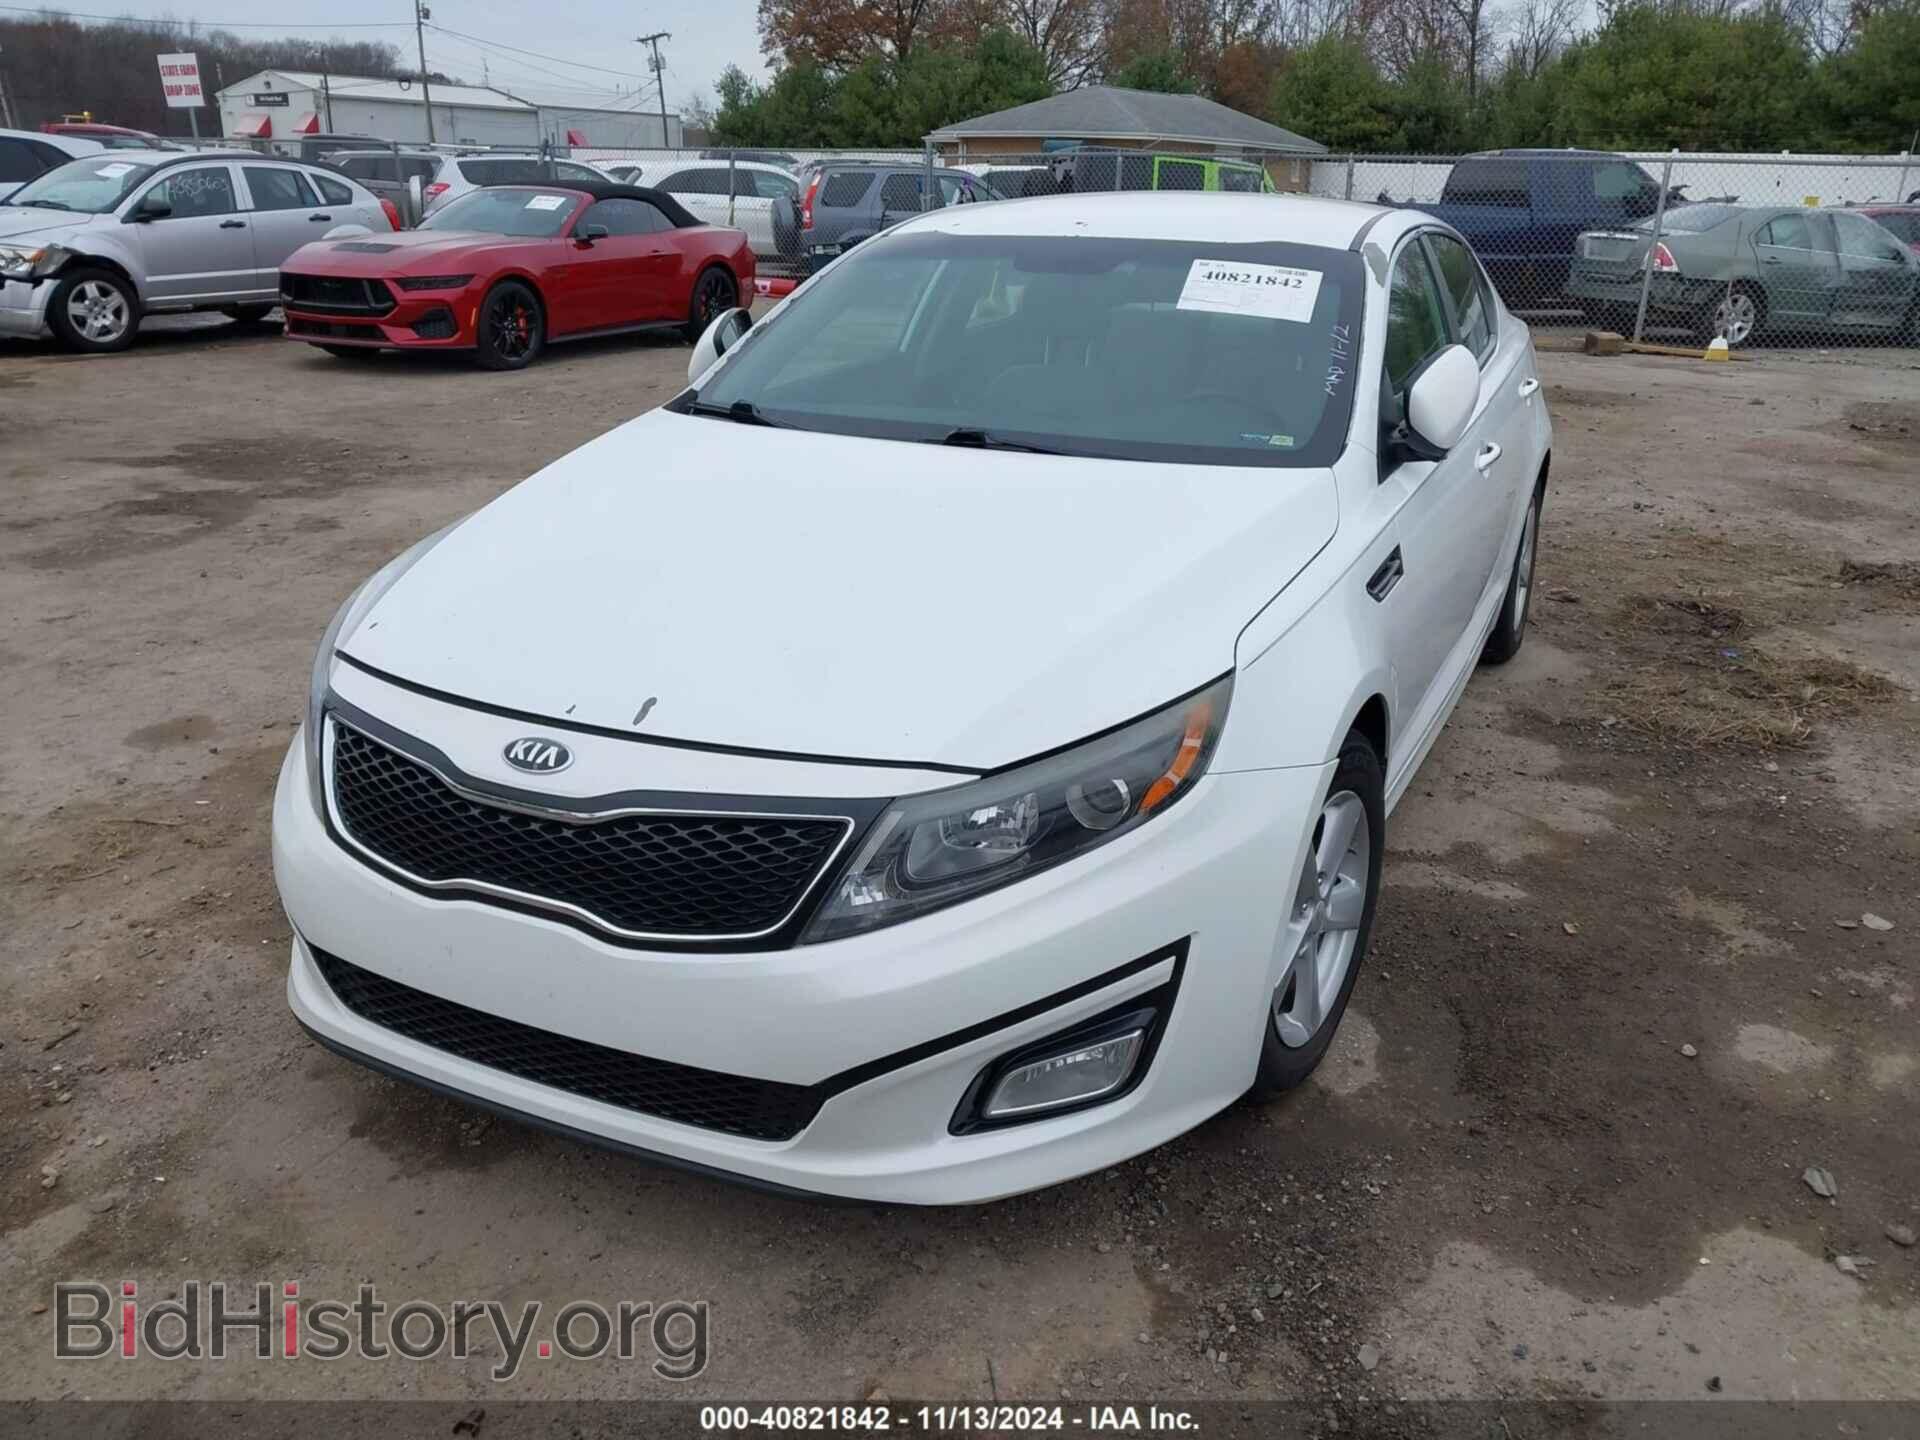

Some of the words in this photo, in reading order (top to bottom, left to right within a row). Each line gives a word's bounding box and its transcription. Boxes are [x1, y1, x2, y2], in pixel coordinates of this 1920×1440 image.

[161, 64, 179, 77] STATE
[180, 64, 197, 76] FARM
[165, 84, 183, 97] DROP
[183, 84, 201, 96] ZONE
[1201, 270, 1304, 289] 40821842
[508, 740, 560, 768] KIA
